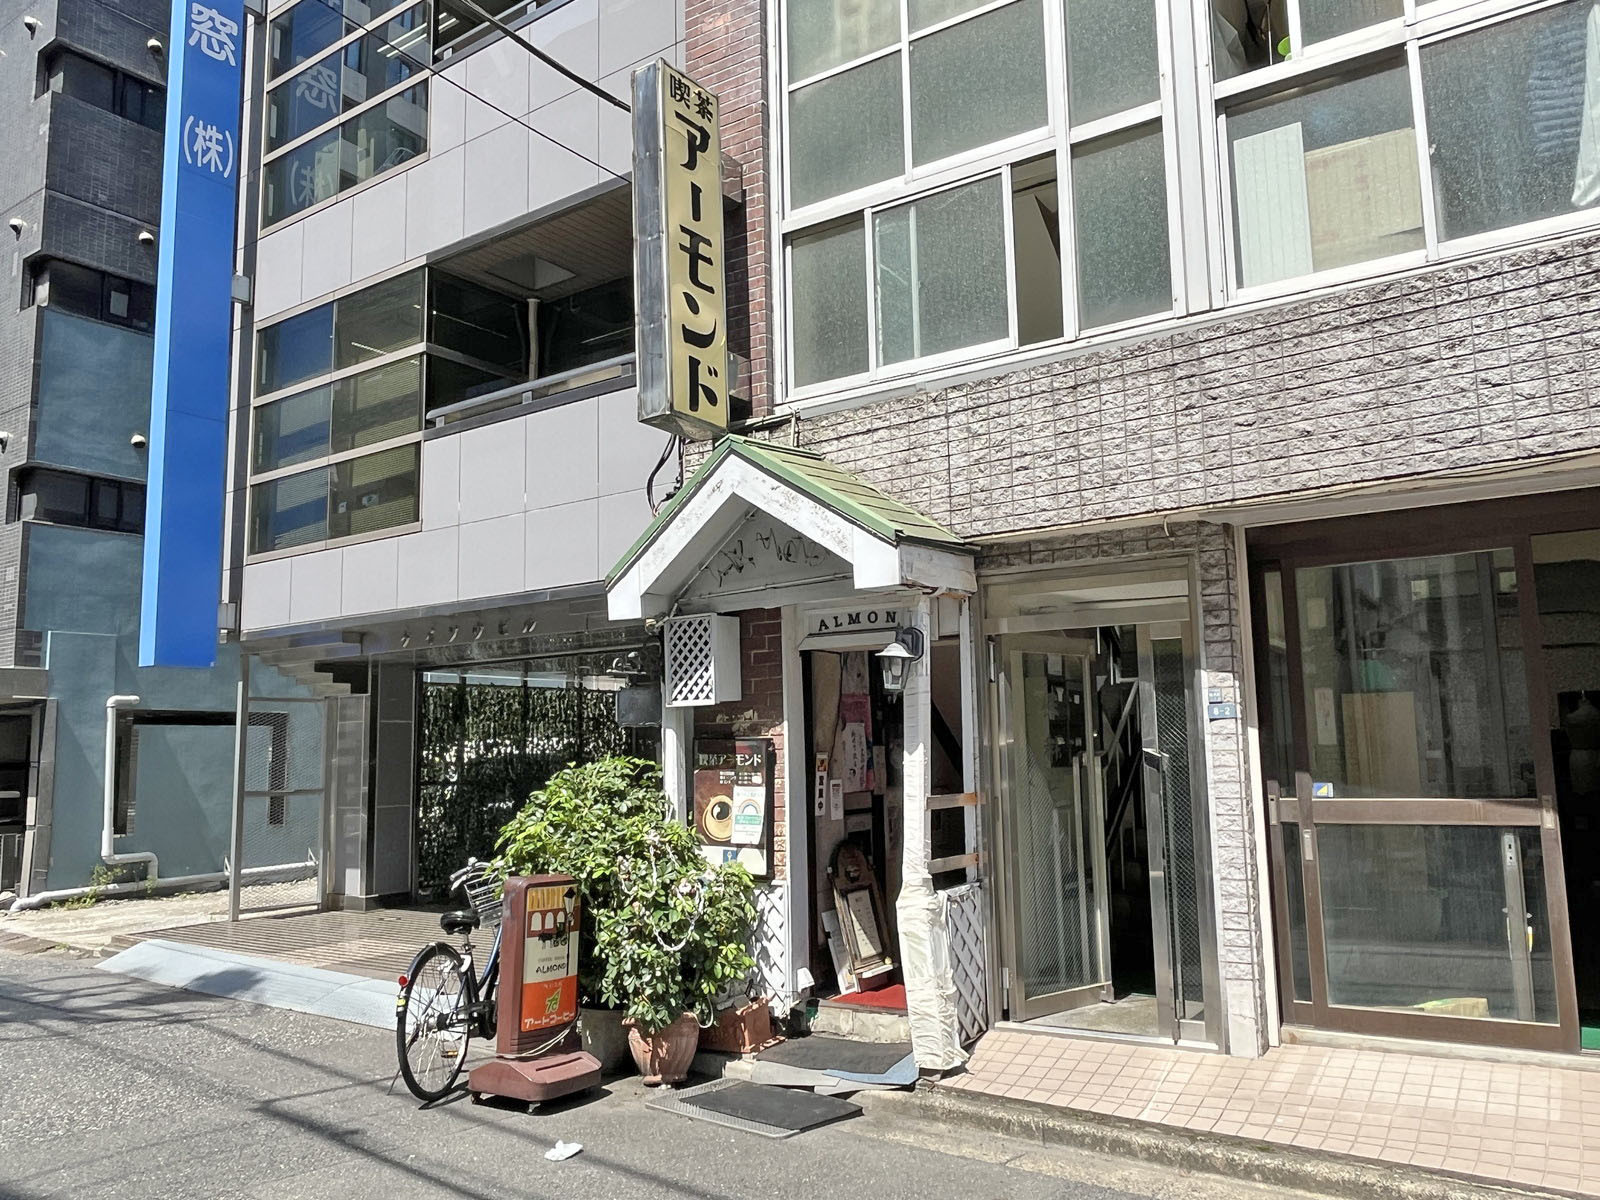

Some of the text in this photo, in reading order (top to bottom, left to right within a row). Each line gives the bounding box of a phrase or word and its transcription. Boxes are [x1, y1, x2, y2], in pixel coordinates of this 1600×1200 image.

[670, 73, 713, 123] 喫茶
[675, 110, 719, 412] アーモンド
[525, 1011, 575, 1029] アートコーヒー
